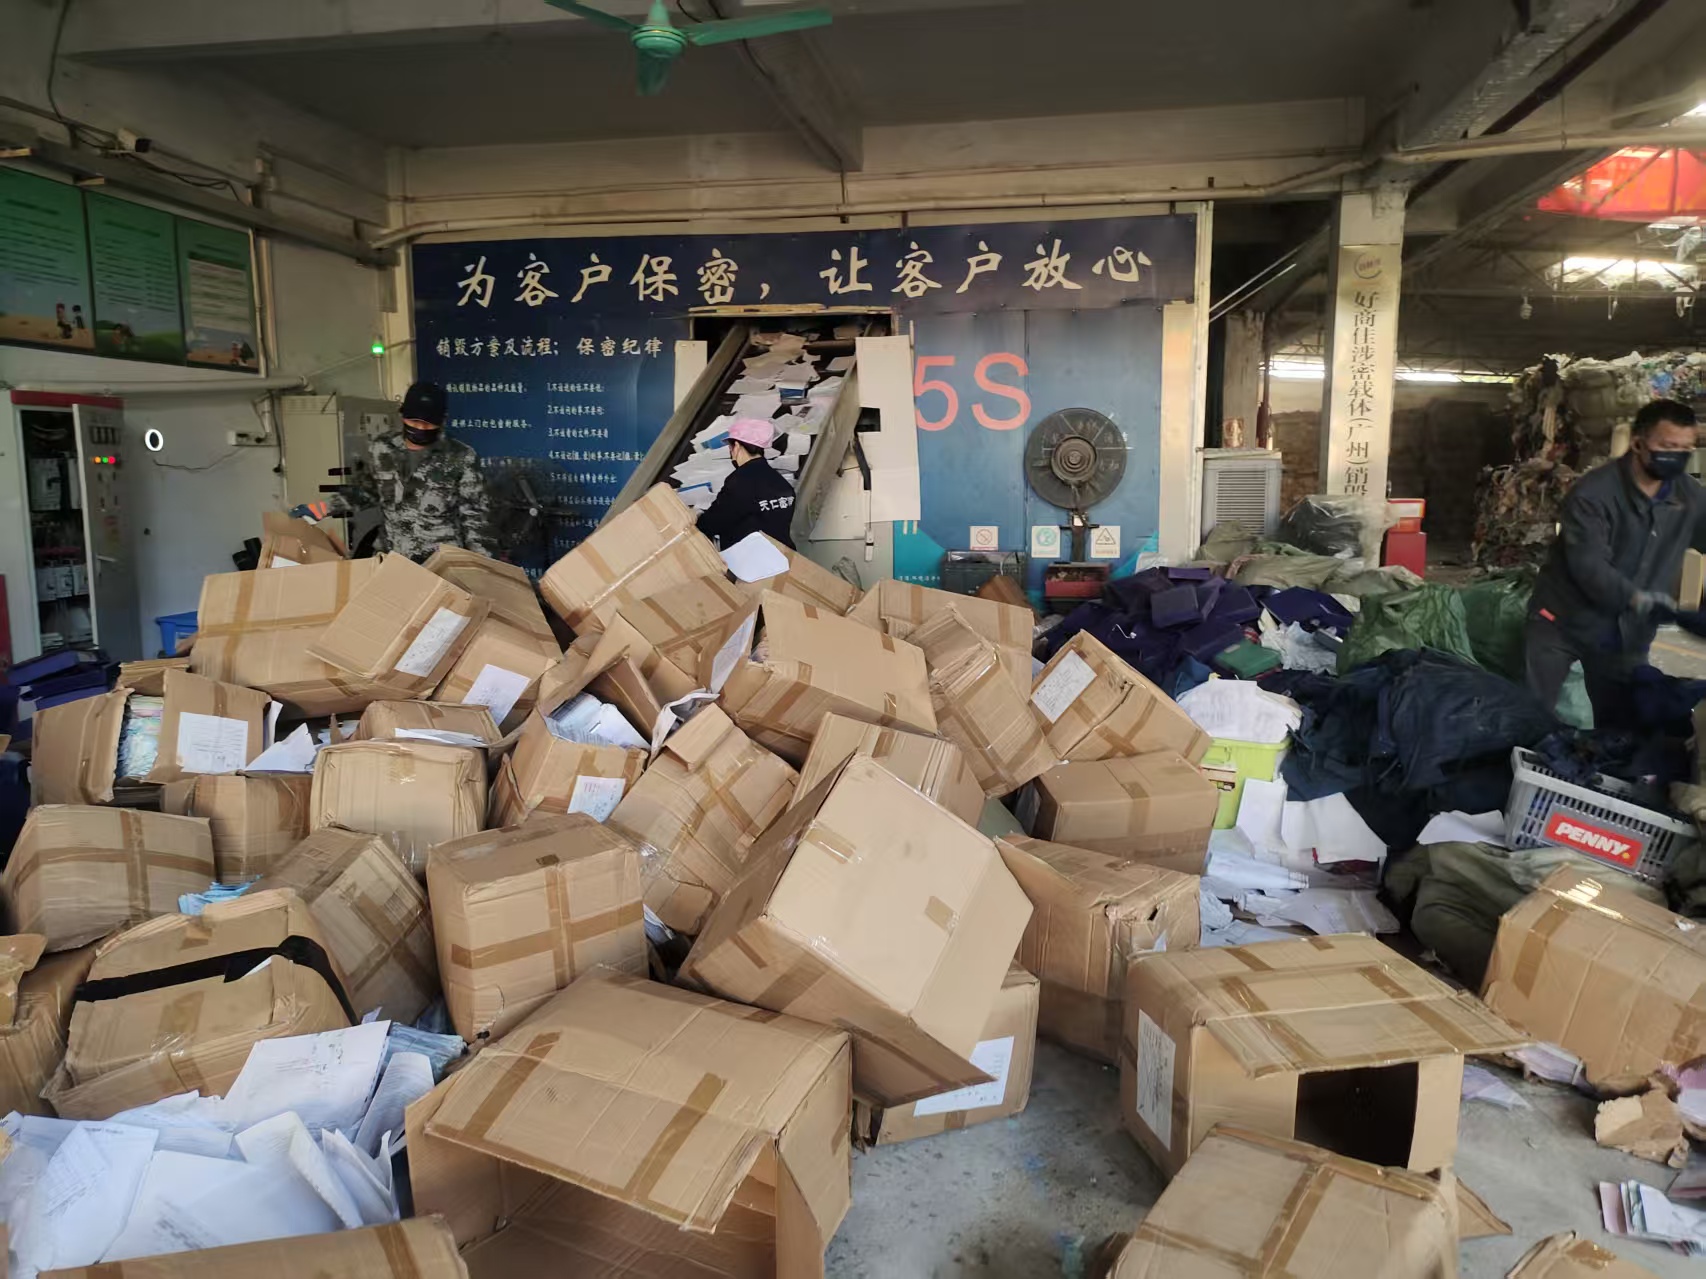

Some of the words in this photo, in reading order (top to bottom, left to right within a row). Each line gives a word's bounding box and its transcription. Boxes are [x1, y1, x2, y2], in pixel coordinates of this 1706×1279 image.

[577, 336, 663, 358] 保密纪律
[914, 352, 1032, 431] 5S
